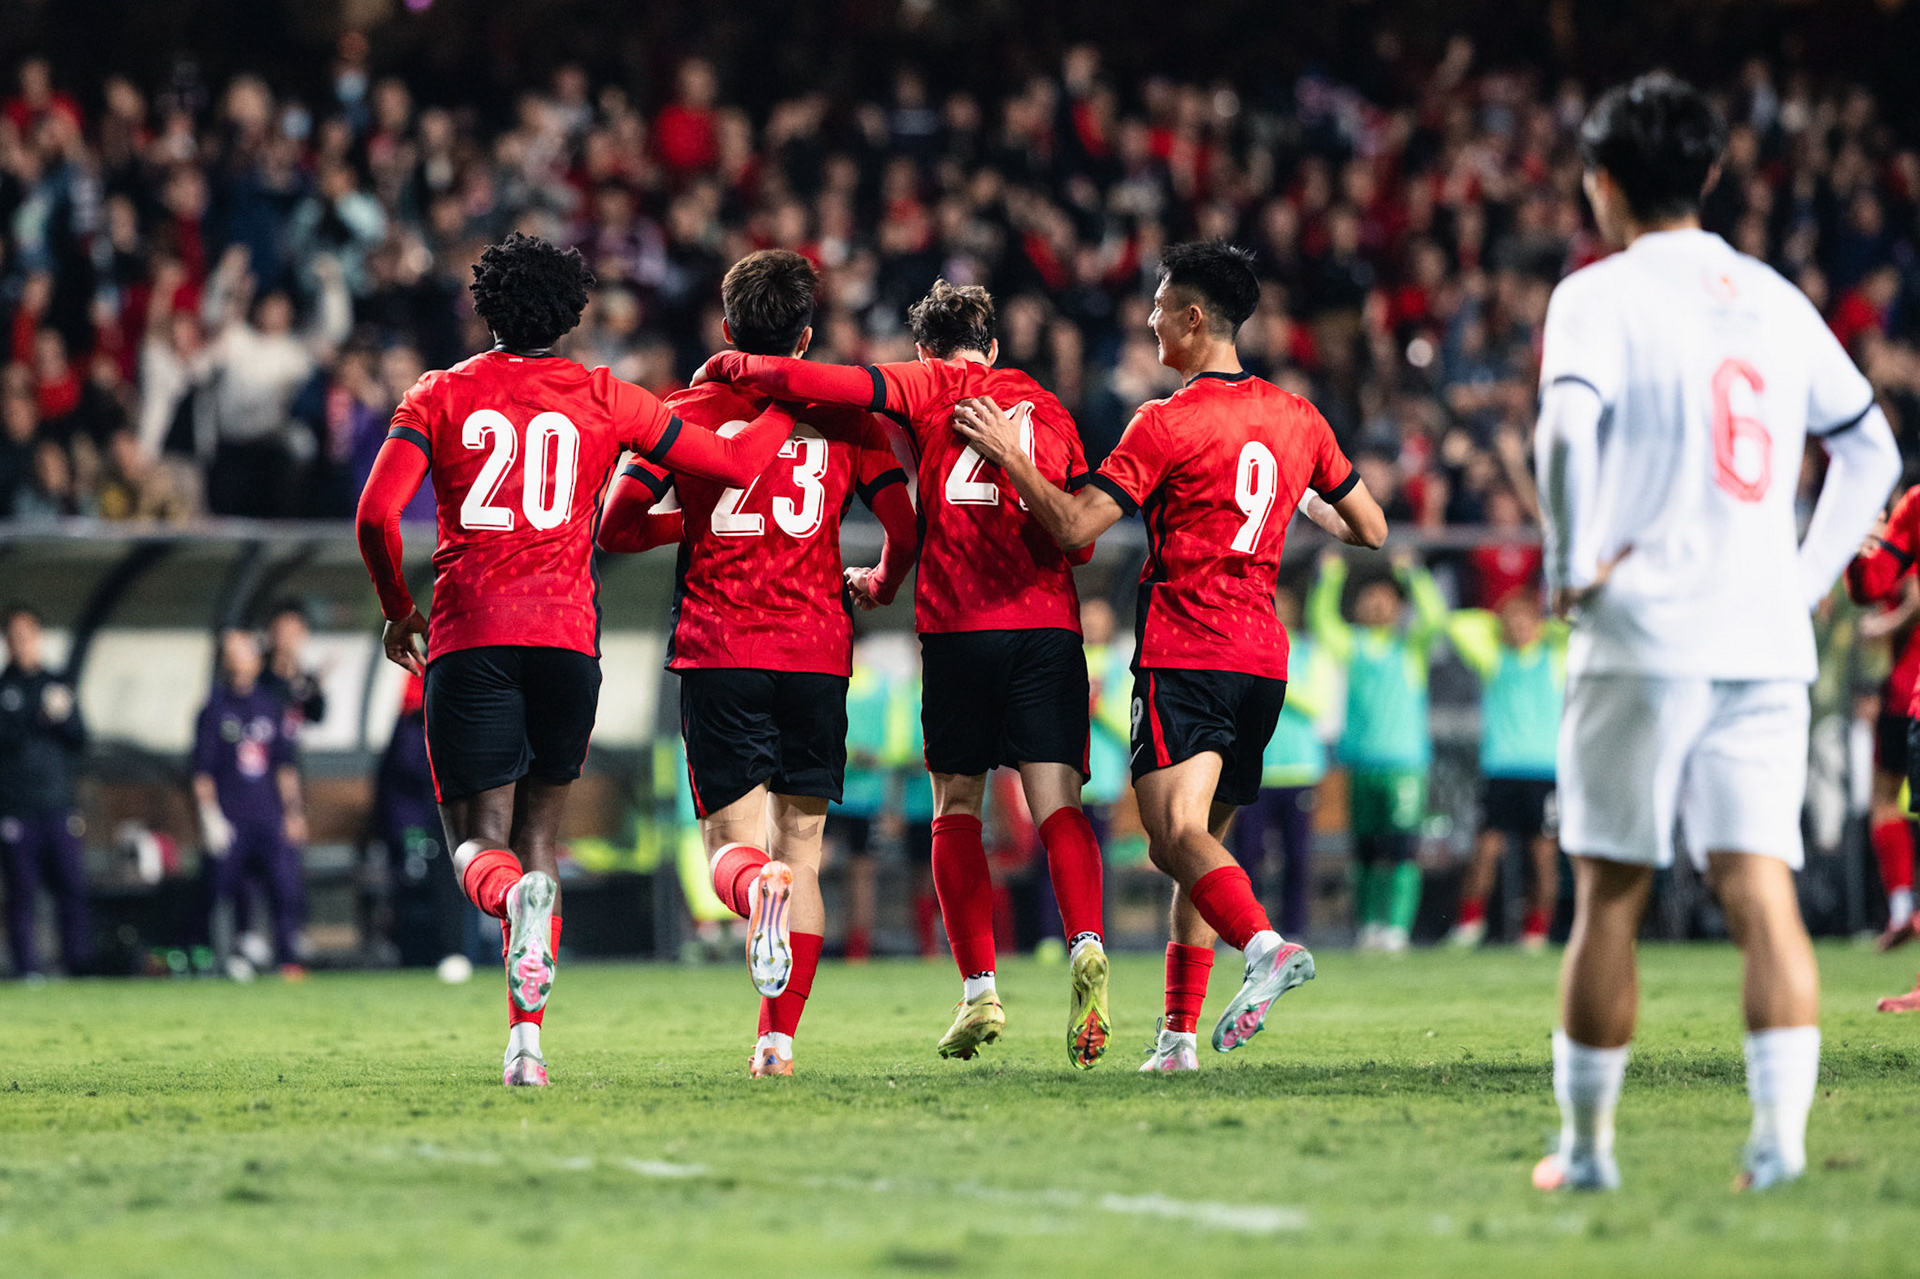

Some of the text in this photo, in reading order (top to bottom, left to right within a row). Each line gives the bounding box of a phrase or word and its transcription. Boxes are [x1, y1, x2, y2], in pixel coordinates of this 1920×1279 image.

[460, 409, 580, 531] 20
[1712, 357, 1773, 503] 6
[1230, 440, 1278, 555] 9
[1131, 696, 1144, 742] 9
